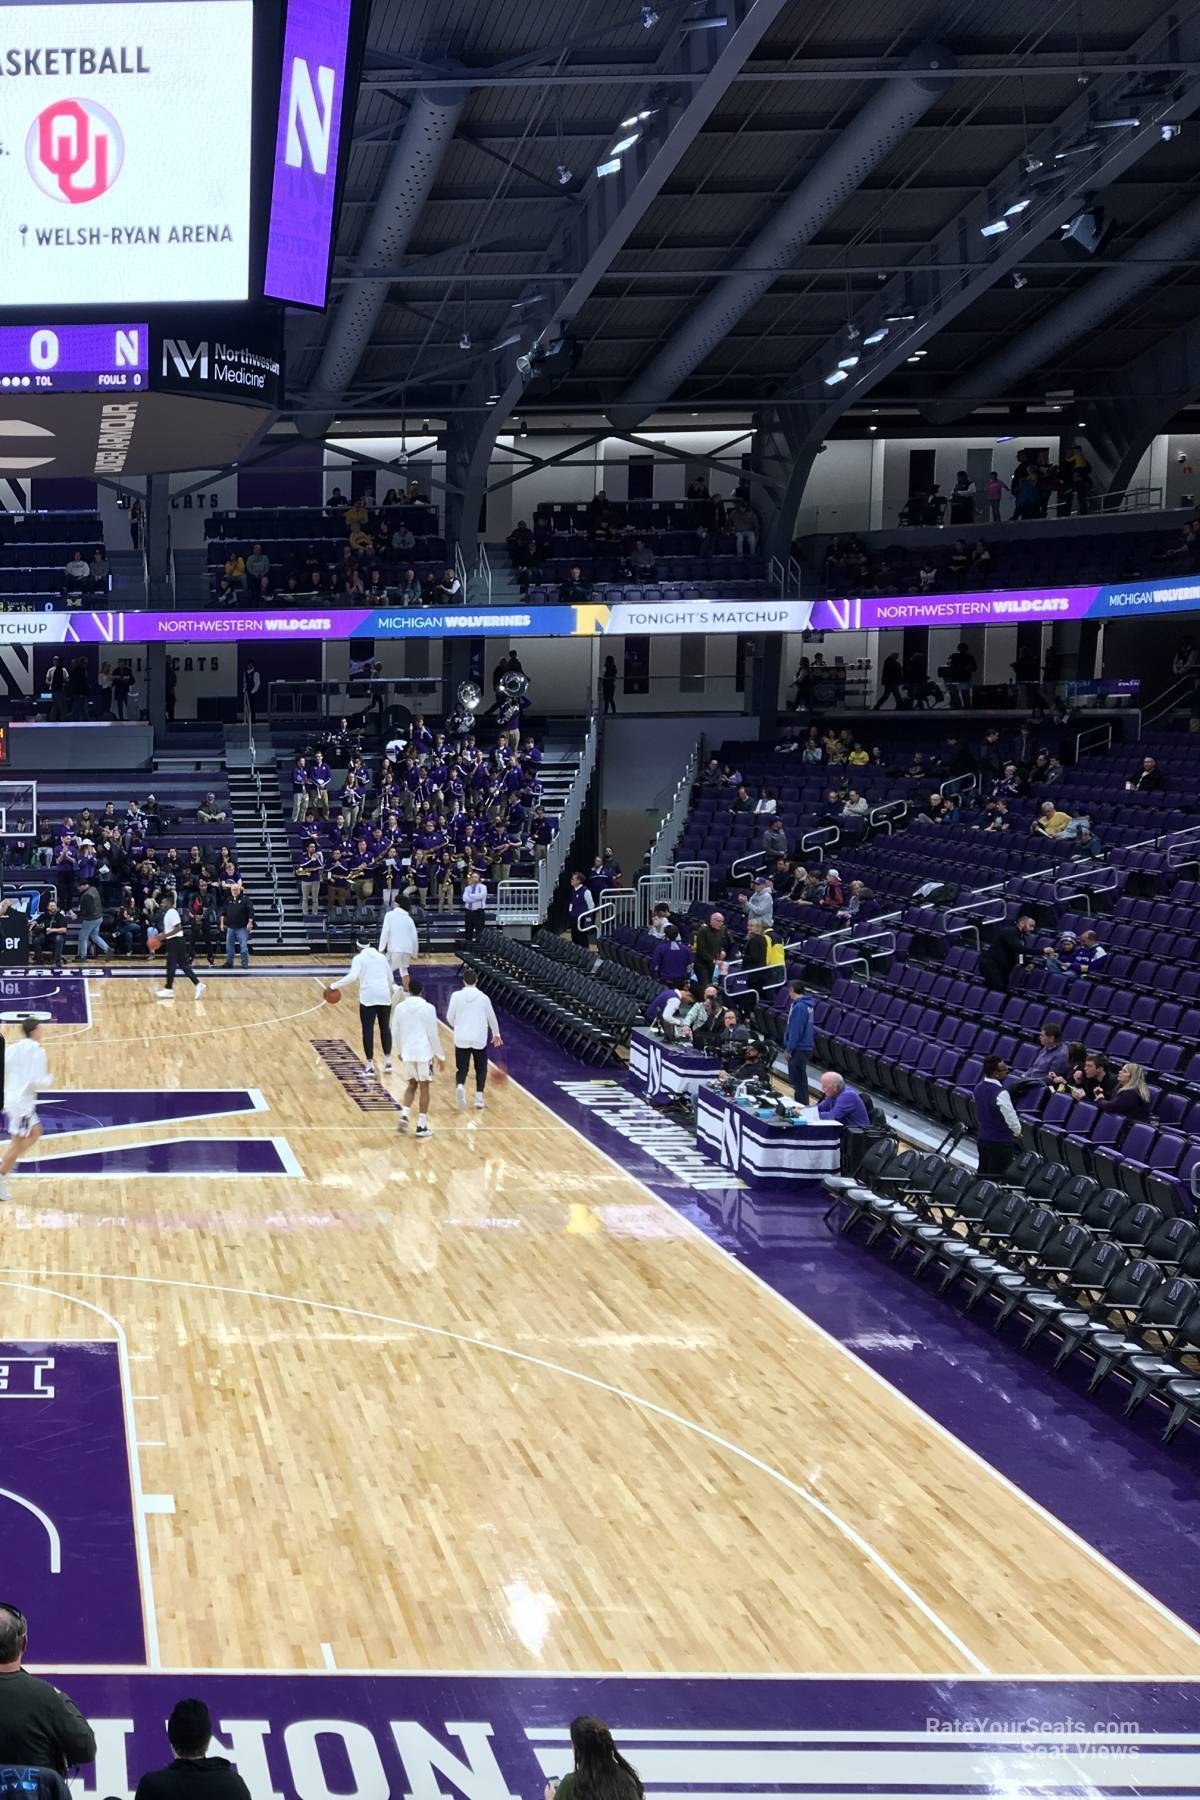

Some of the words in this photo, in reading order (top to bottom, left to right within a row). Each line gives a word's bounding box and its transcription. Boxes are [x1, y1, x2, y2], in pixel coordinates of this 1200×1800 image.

[36, 226, 160, 246] WELSH-RYAN
[168, 224, 233, 243] ARENA
[30, 329, 59, 370] 0
[115, 330, 139, 366] N
[35, 375, 53, 386] TOL
[98, 374, 127, 386] FOULS
[133, 373, 141, 386] 0
[1109, 592, 1153, 607] MICHIGAN
[877, 601, 991, 619] NORTHWESTERN
[993, 597, 1069, 613] WILDCATS
[378, 616, 443, 629] MICHIGAN
[445, 615, 531, 627] WOLVERINES
[628, 611, 708, 625] TONIGHT'S
[711, 610, 788, 624] MATCHUP
[158, 619, 263, 633] NORTHWESTERN
[265, 618, 331, 631] WILDCATS
